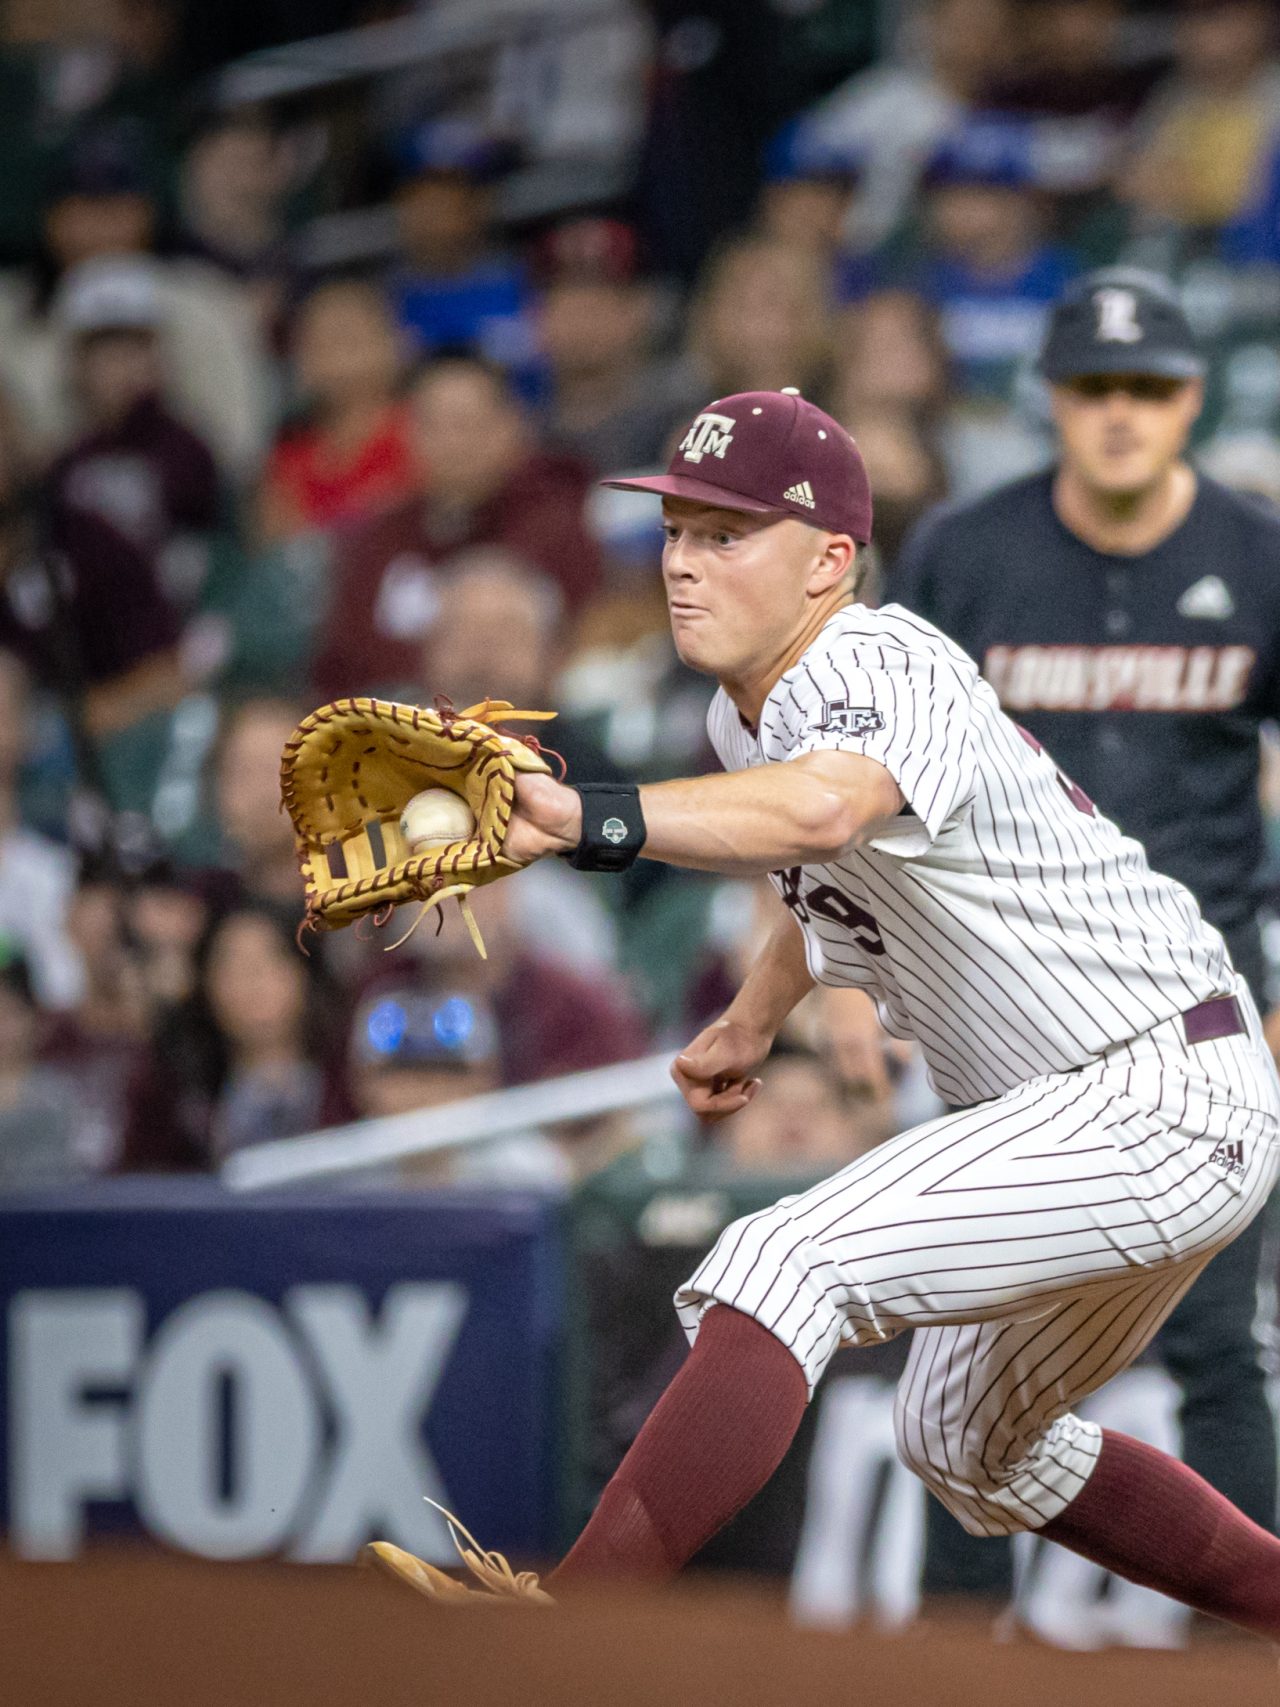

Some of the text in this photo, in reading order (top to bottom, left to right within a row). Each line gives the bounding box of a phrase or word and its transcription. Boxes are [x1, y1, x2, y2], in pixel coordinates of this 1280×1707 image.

[783, 490, 816, 510] adidas
[985, 645, 1254, 712] LOUISVILLE
[8, 1281, 468, 1567] FOX
